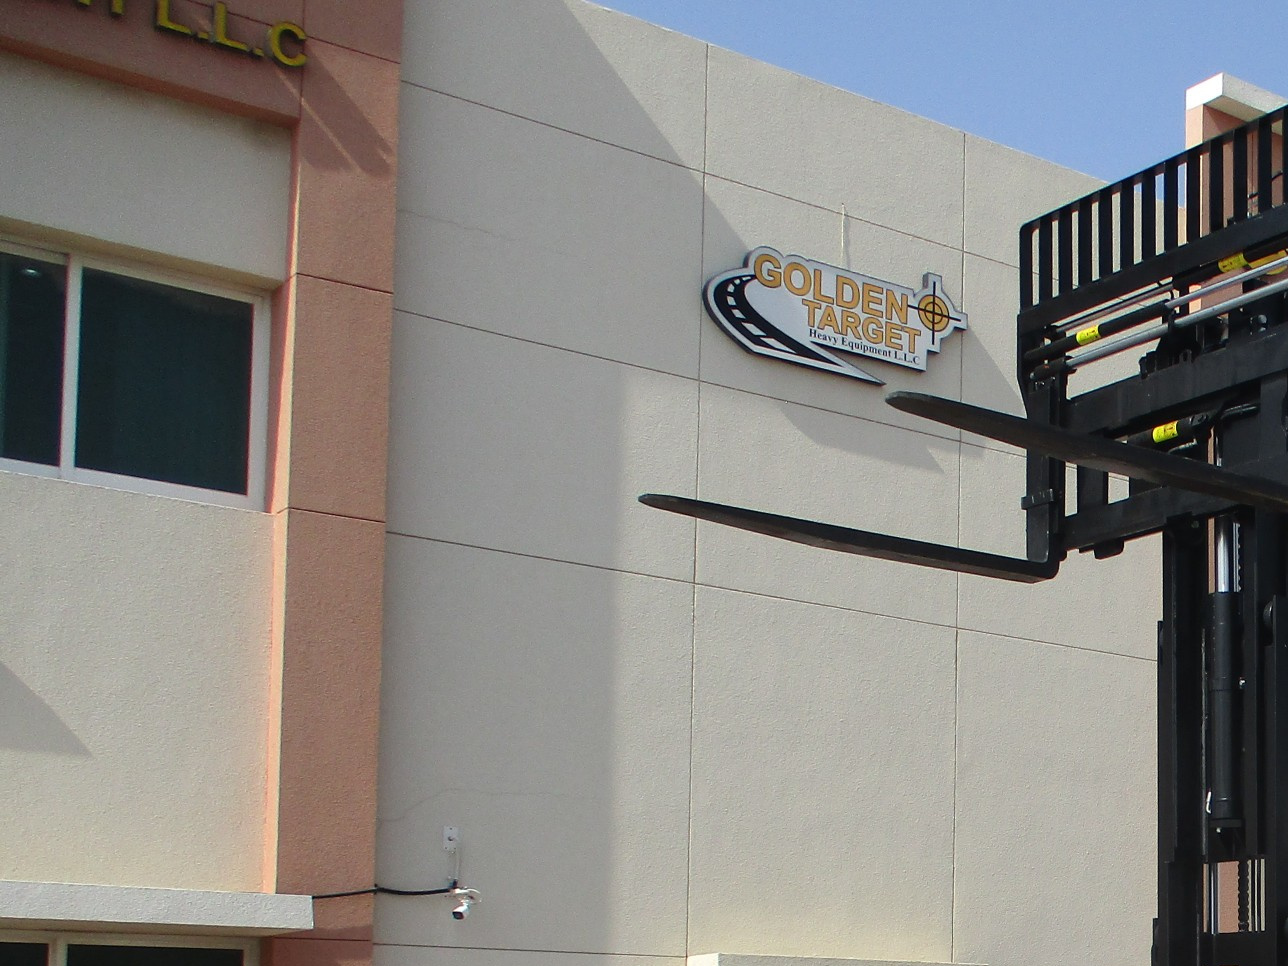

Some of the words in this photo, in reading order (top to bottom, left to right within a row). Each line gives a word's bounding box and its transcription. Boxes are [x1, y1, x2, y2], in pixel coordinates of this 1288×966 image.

[753, 253, 910, 325] GOLDEN
[801, 298, 923, 354] TARGET
[808, 327, 840, 347] Heavy
[841, 336, 893, 359] Equipment
[894, 350, 921, 366] L.L.C
